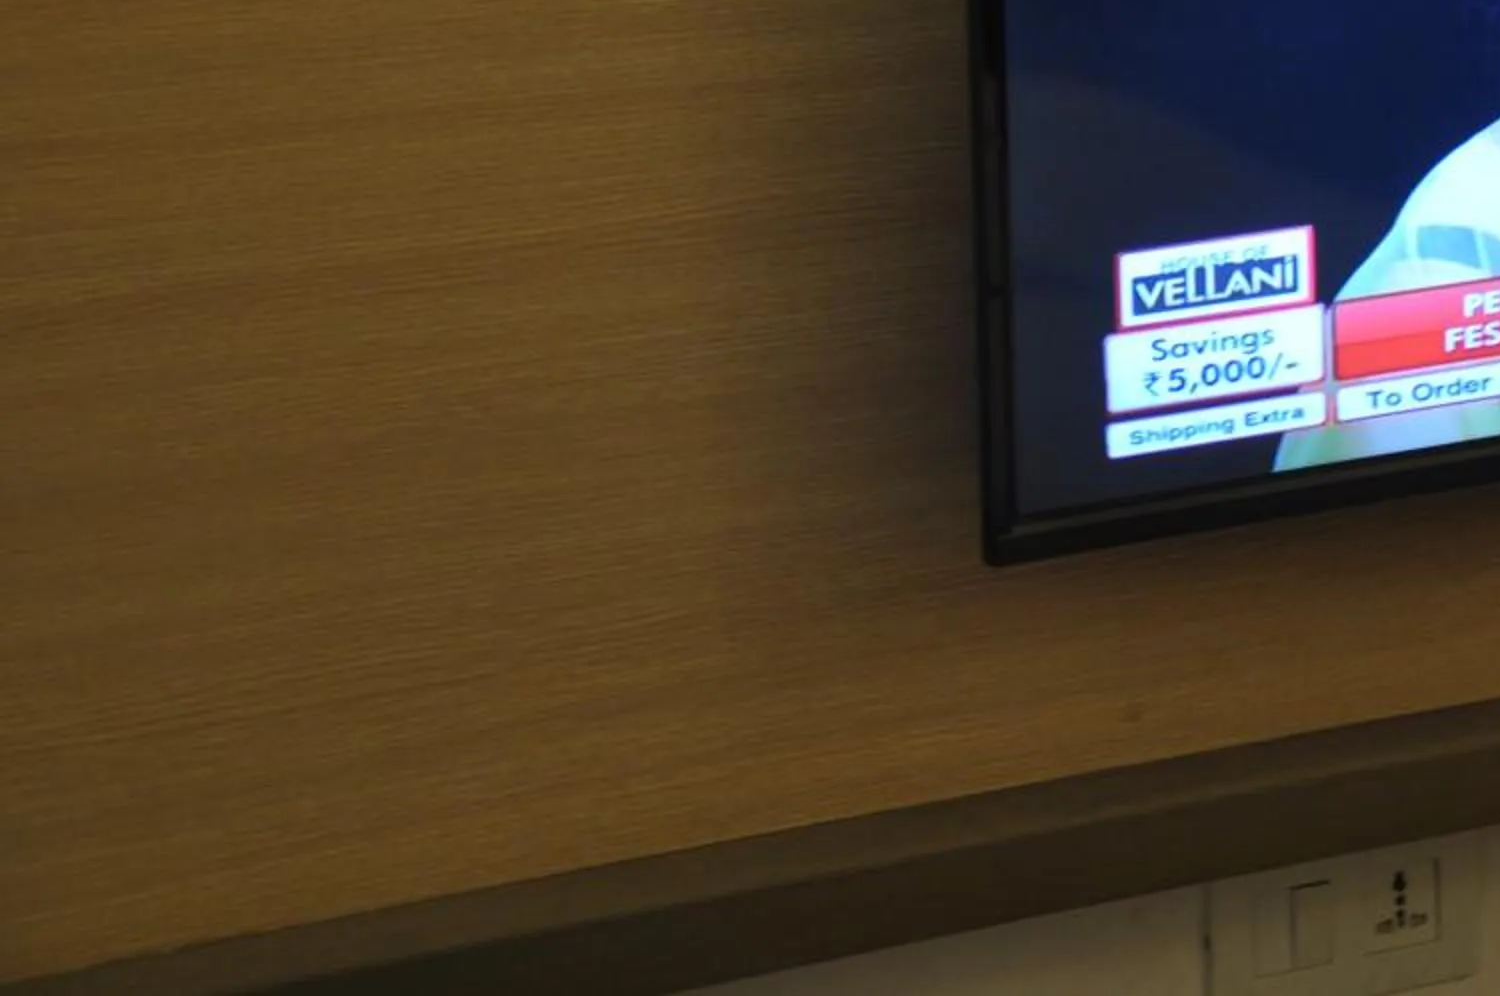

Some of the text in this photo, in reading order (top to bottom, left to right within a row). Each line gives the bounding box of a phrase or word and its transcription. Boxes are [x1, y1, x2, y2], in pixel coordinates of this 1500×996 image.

[1150, 328, 1276, 362] Savings
[1366, 389, 1402, 410] To
[1411, 376, 1492, 403] Order
[1129, 406, 1305, 446] Shipping Extra
